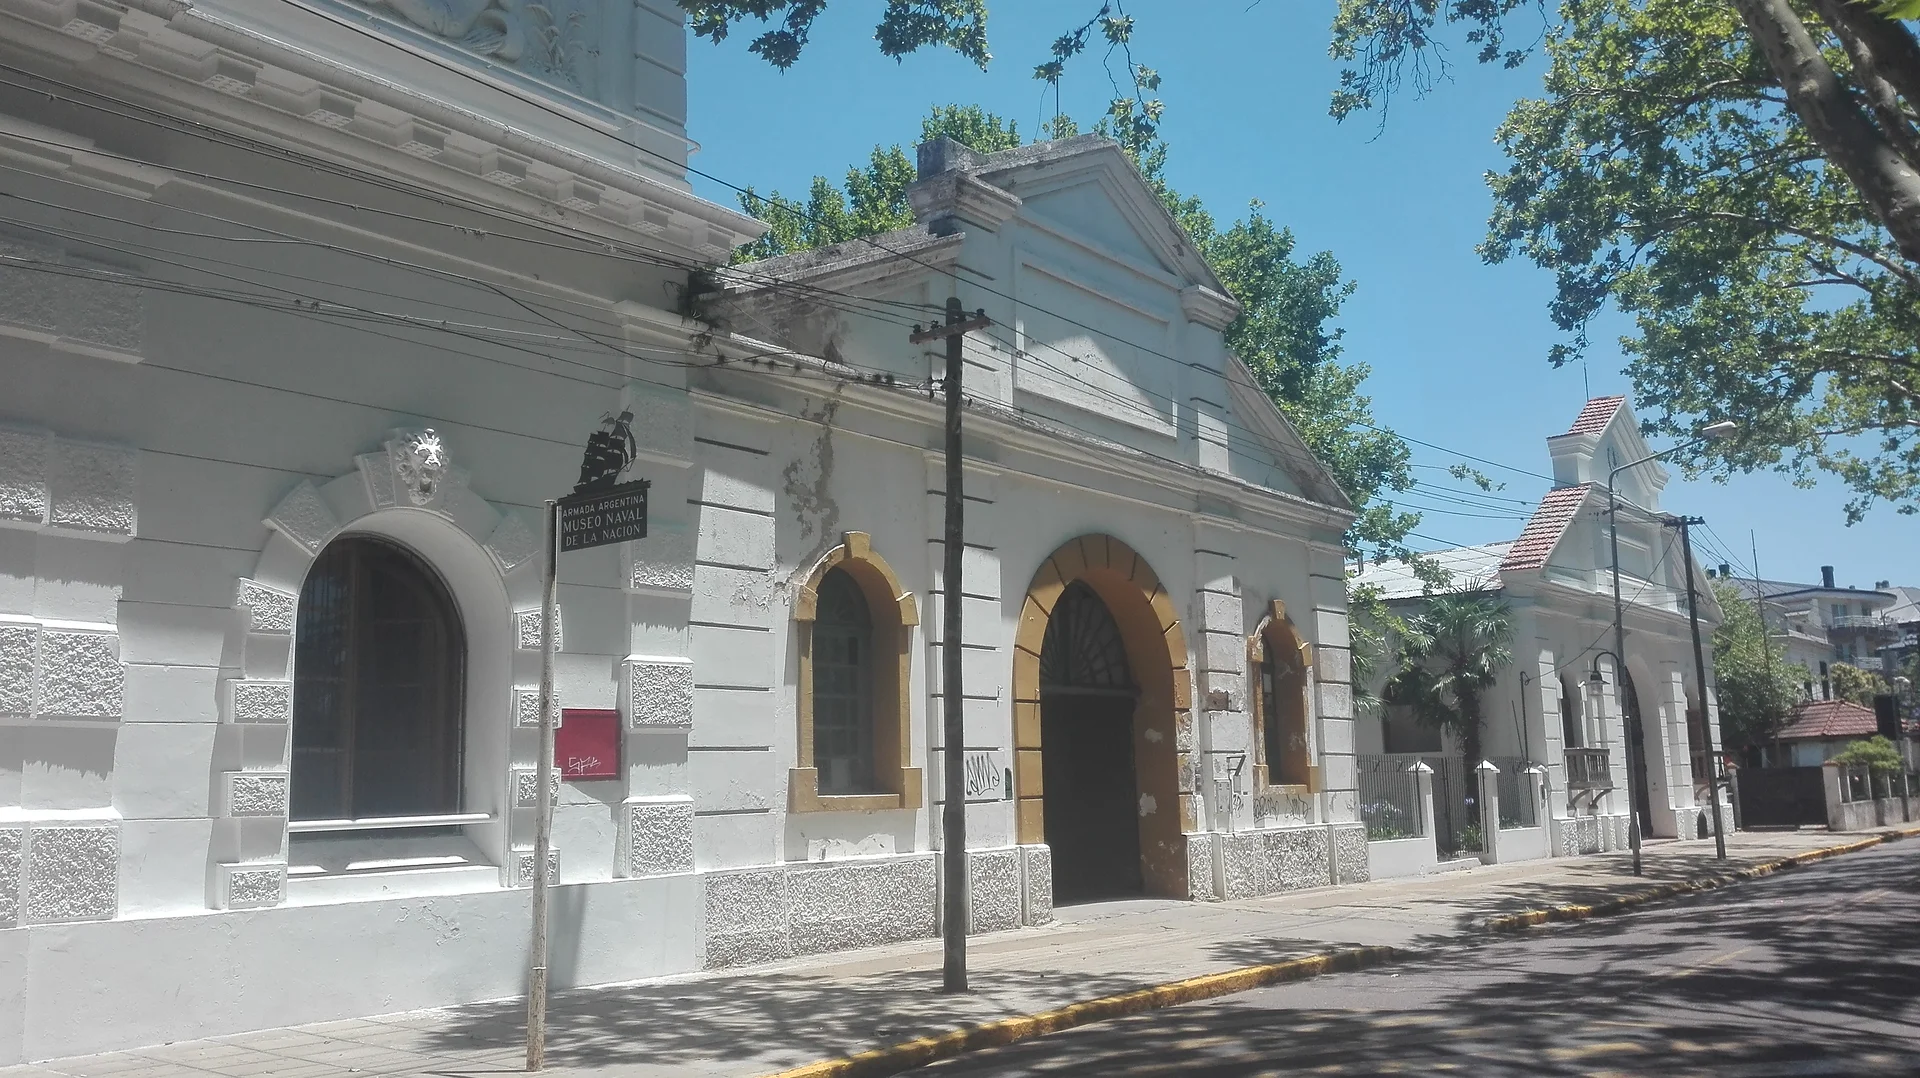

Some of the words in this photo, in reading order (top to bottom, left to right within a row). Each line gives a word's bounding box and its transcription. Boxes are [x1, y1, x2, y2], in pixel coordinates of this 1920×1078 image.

[563, 504, 595, 518] ARMADA
[599, 494, 645, 511] ARGENTINA
[563, 515, 602, 533] MUSEO
[606, 507, 643, 526] NAVAL
[566, 535, 579, 547] DE
[583, 532, 597, 544] LA
[603, 524, 640, 541] NACION
